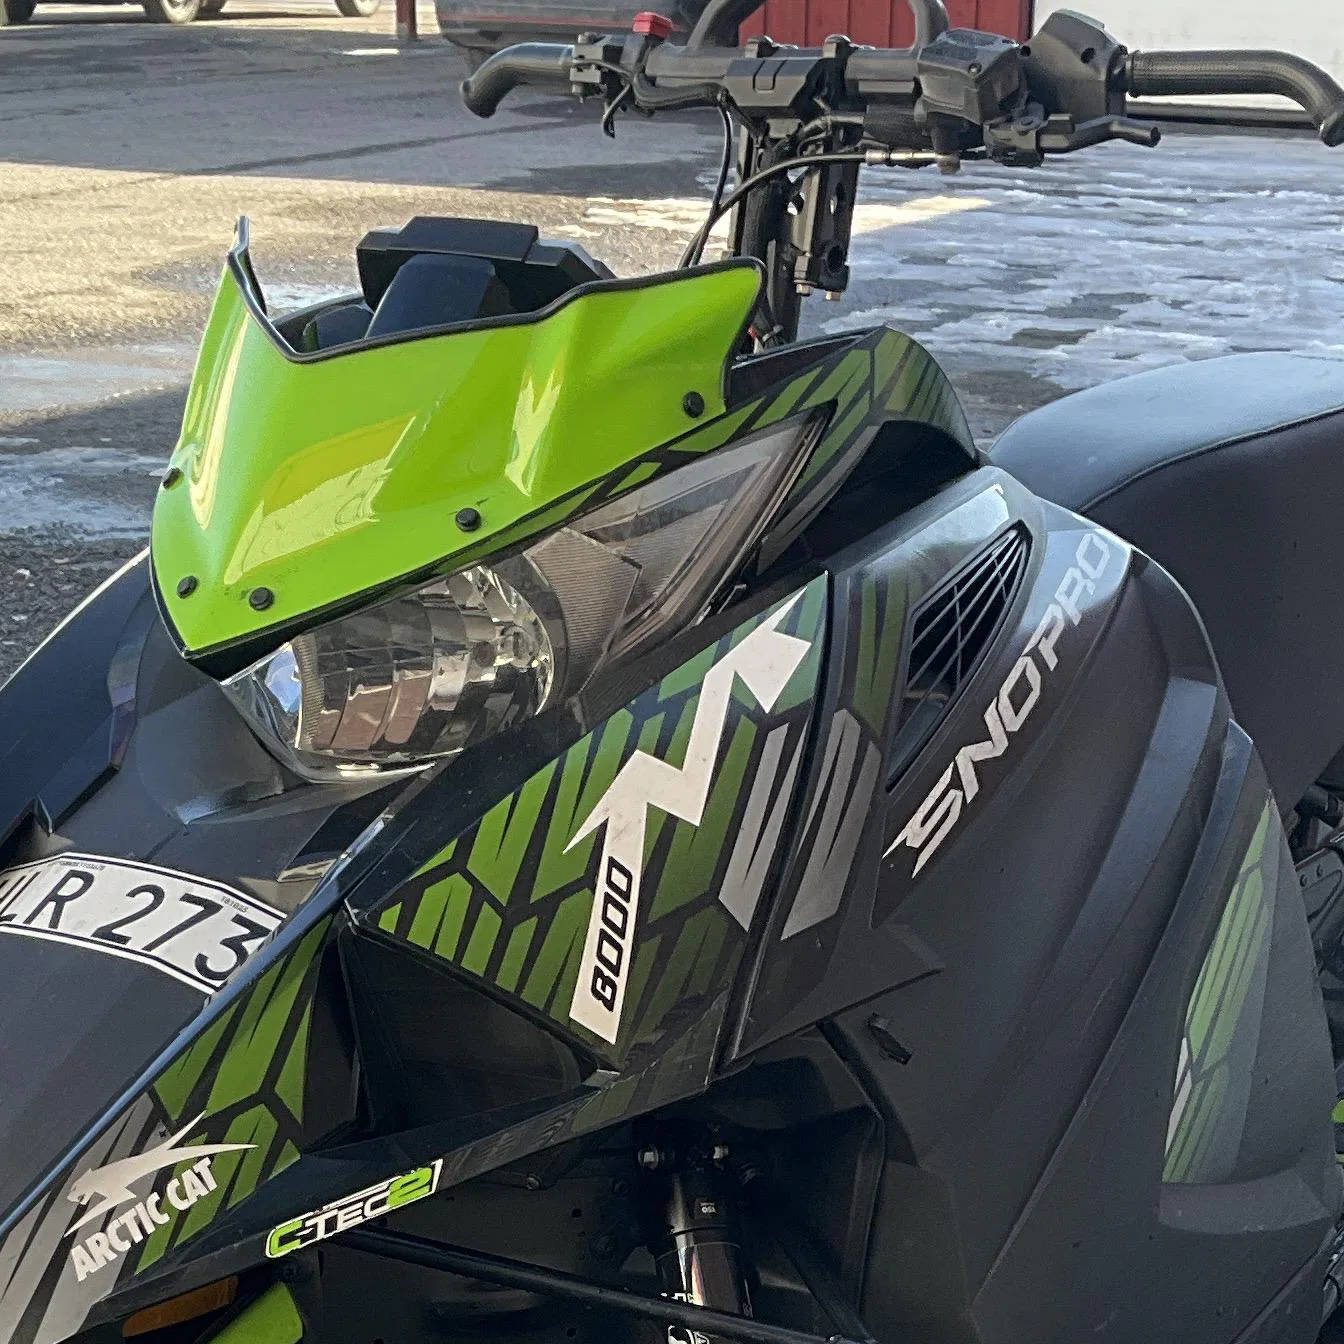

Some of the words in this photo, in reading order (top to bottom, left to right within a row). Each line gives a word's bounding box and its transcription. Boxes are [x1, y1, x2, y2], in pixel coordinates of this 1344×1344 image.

[91, 884, 272, 981] 273
[591, 856, 633, 1012] 8000
[71, 1192, 170, 1282] ARCTIC
[166, 1157, 218, 1211] CAT
